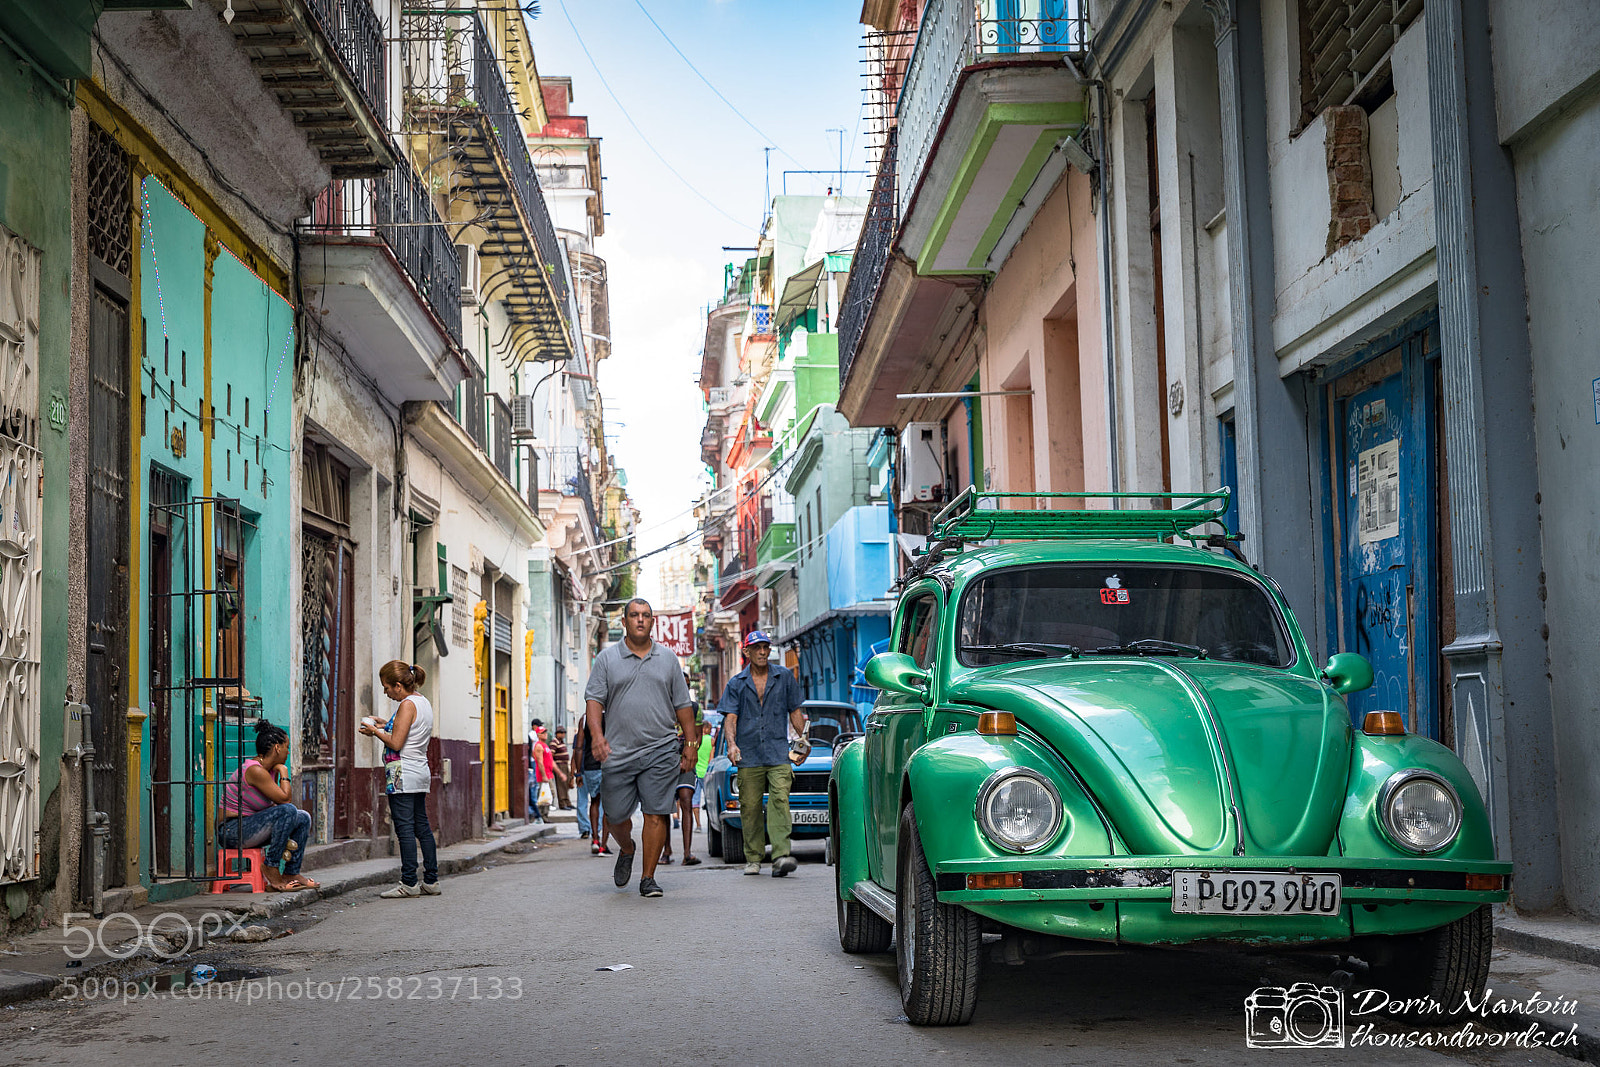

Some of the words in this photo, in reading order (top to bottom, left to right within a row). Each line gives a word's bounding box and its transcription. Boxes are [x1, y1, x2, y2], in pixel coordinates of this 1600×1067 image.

[52, 401, 65, 424] 210
[1101, 590, 1118, 603] 13
[1181, 877, 1189, 908] CUBA
